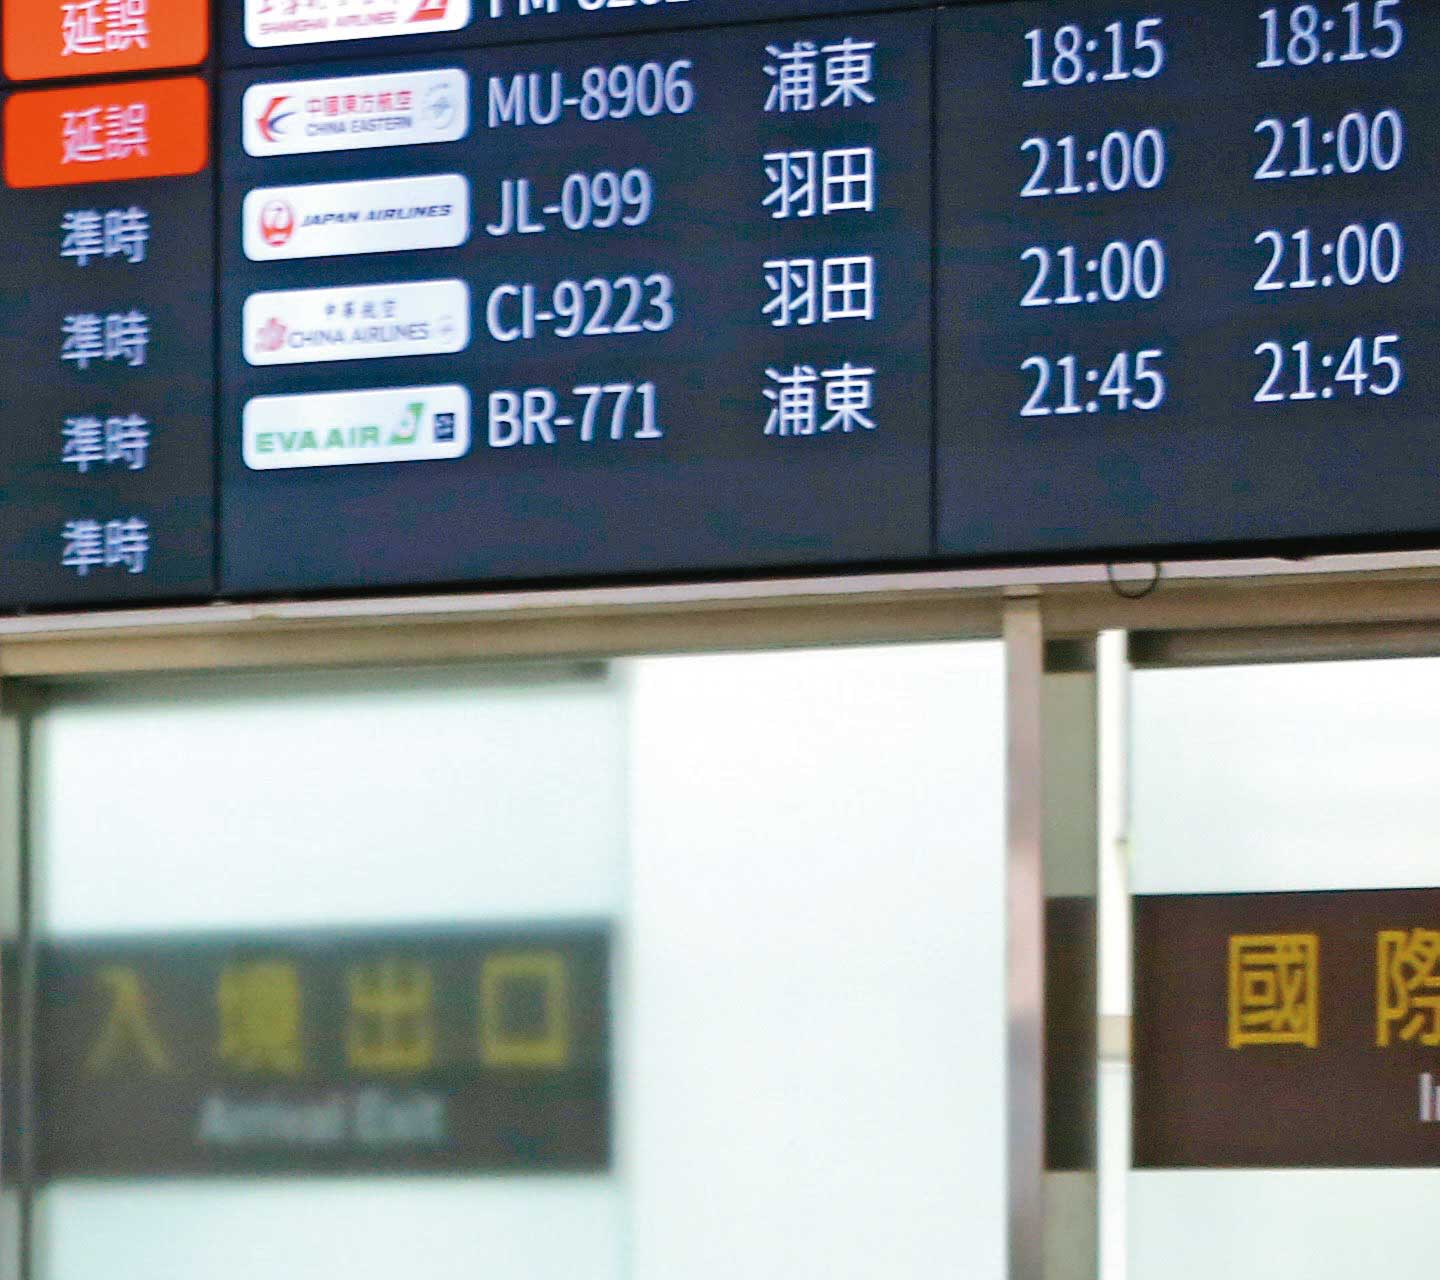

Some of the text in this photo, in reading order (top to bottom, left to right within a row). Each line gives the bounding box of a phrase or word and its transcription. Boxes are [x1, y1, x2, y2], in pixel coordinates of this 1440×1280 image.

[62, 0, 149, 57] 延誤
[489, 0, 1404, 129] MU-8906 浦東 18:15 18:15
[63, 104, 149, 165] 延誤
[305, 116, 413, 137] CHINA EASTERN
[487, 110, 1404, 237] JL-099 羽田 21:00 21:00
[61, 207, 151, 267] 準時
[300, 204, 453, 228] JAPAN AIRLINES
[487, 222, 1404, 343] CI-9223 羽田 21:00 21:00
[62, 311, 150, 369] 準時
[286, 321, 430, 349] CHINA AIRLINES
[489, 334, 1403, 449] BR-771 浦東 21:45 21:45
[63, 414, 151, 473] 準時
[254, 424, 380, 455] EVA AIR
[63, 518, 150, 576] 準時
[1226, 927, 1440, 1051] 國際
